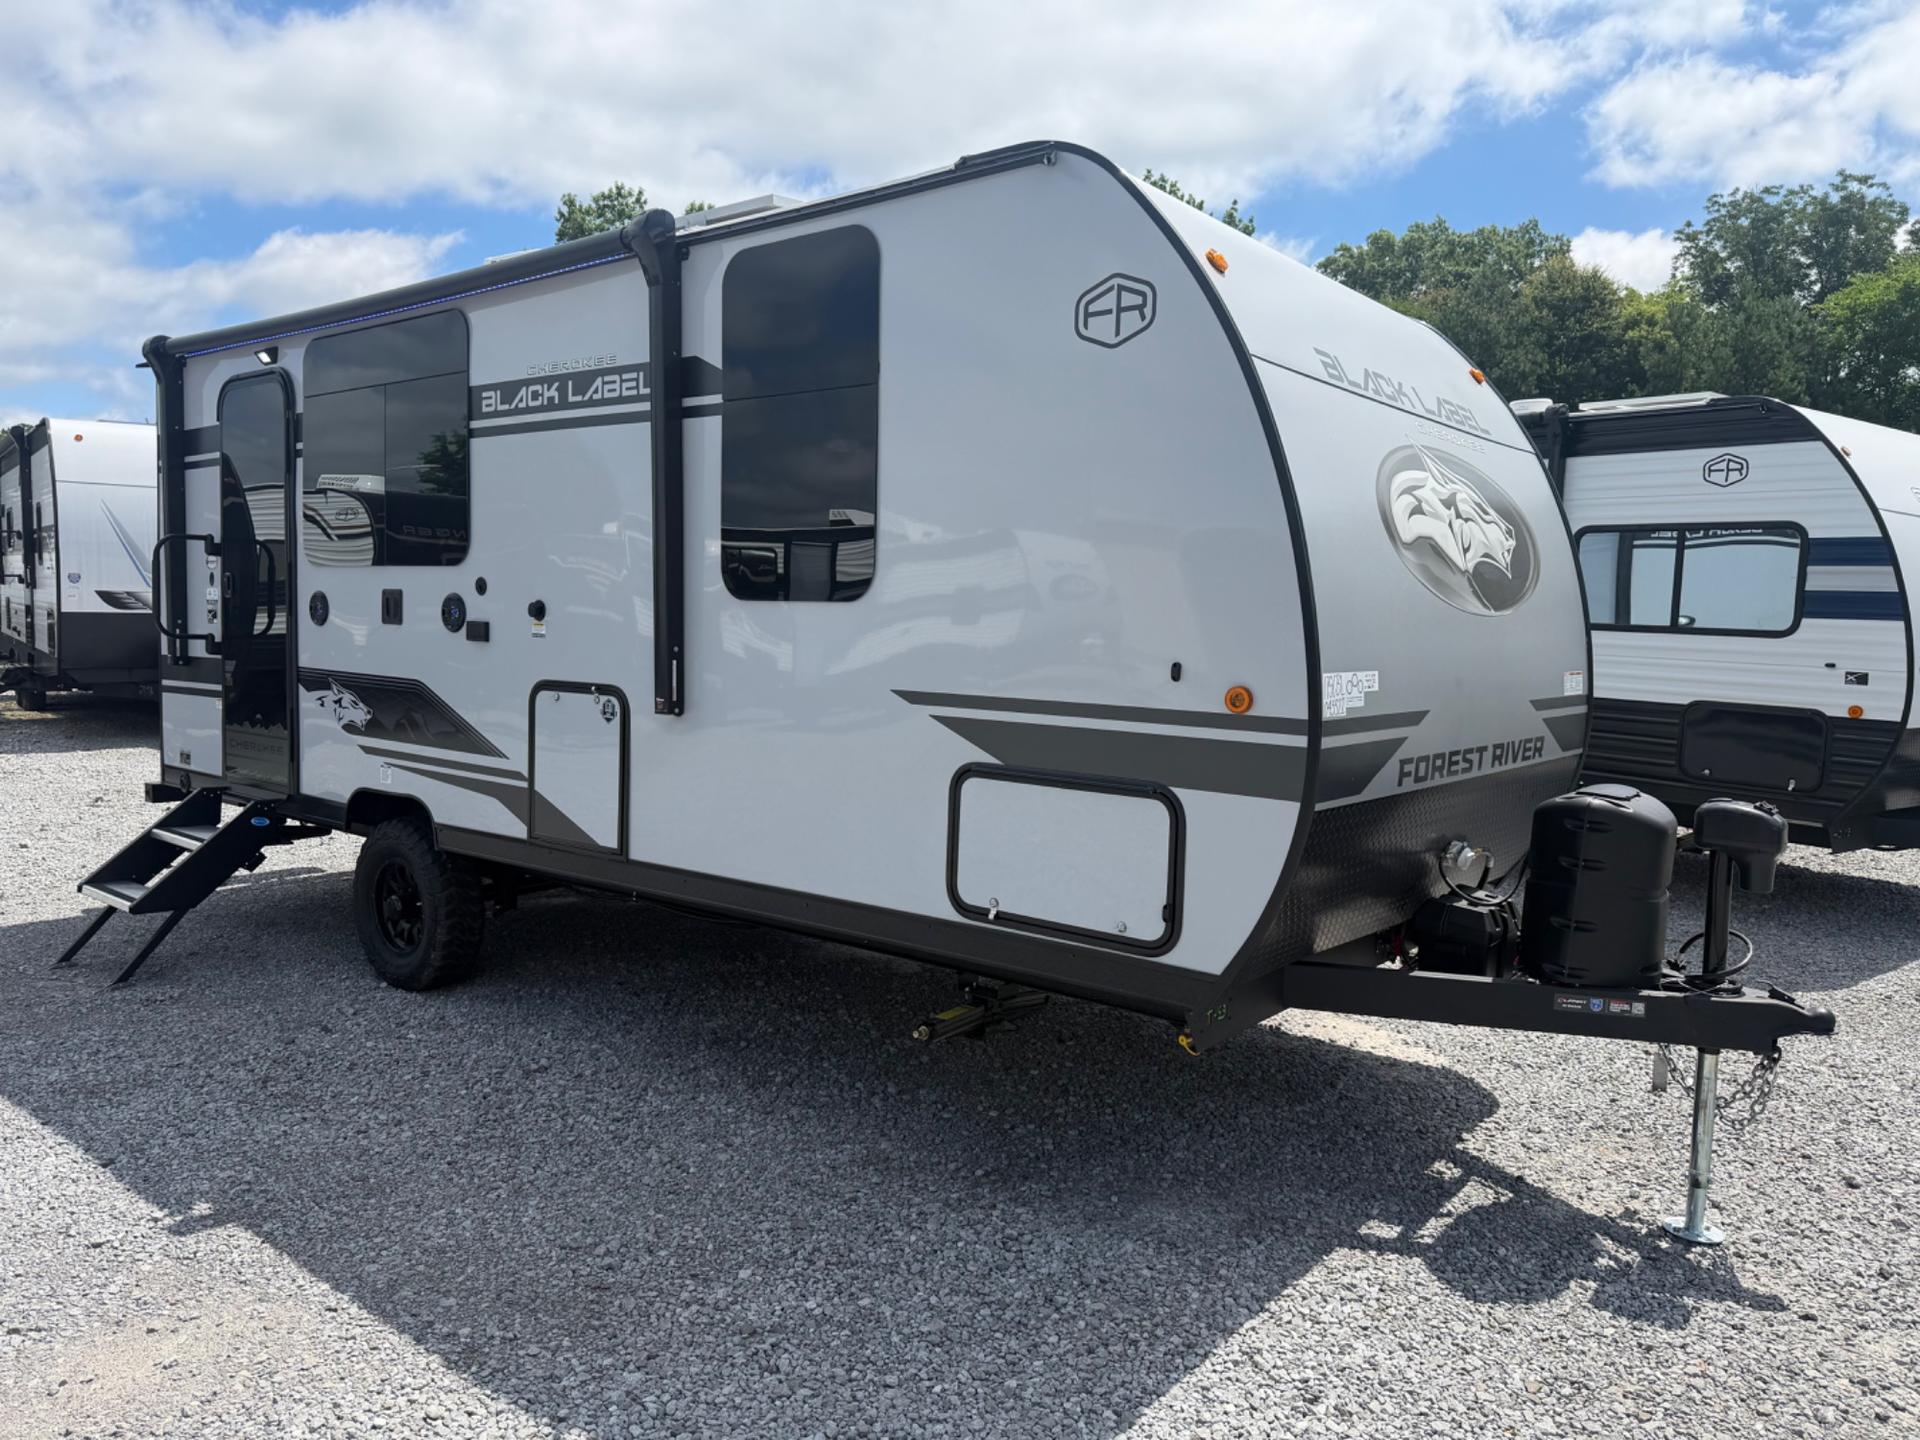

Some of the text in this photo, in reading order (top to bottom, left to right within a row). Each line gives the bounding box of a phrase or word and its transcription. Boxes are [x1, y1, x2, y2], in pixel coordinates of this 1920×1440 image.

[526, 353, 617, 377] CHEROKEE
[481, 371, 651, 413] BLACK LABEL
[1313, 347, 1492, 436] BLACK LABEL
[1397, 736, 1545, 787] FOREST RIVER
